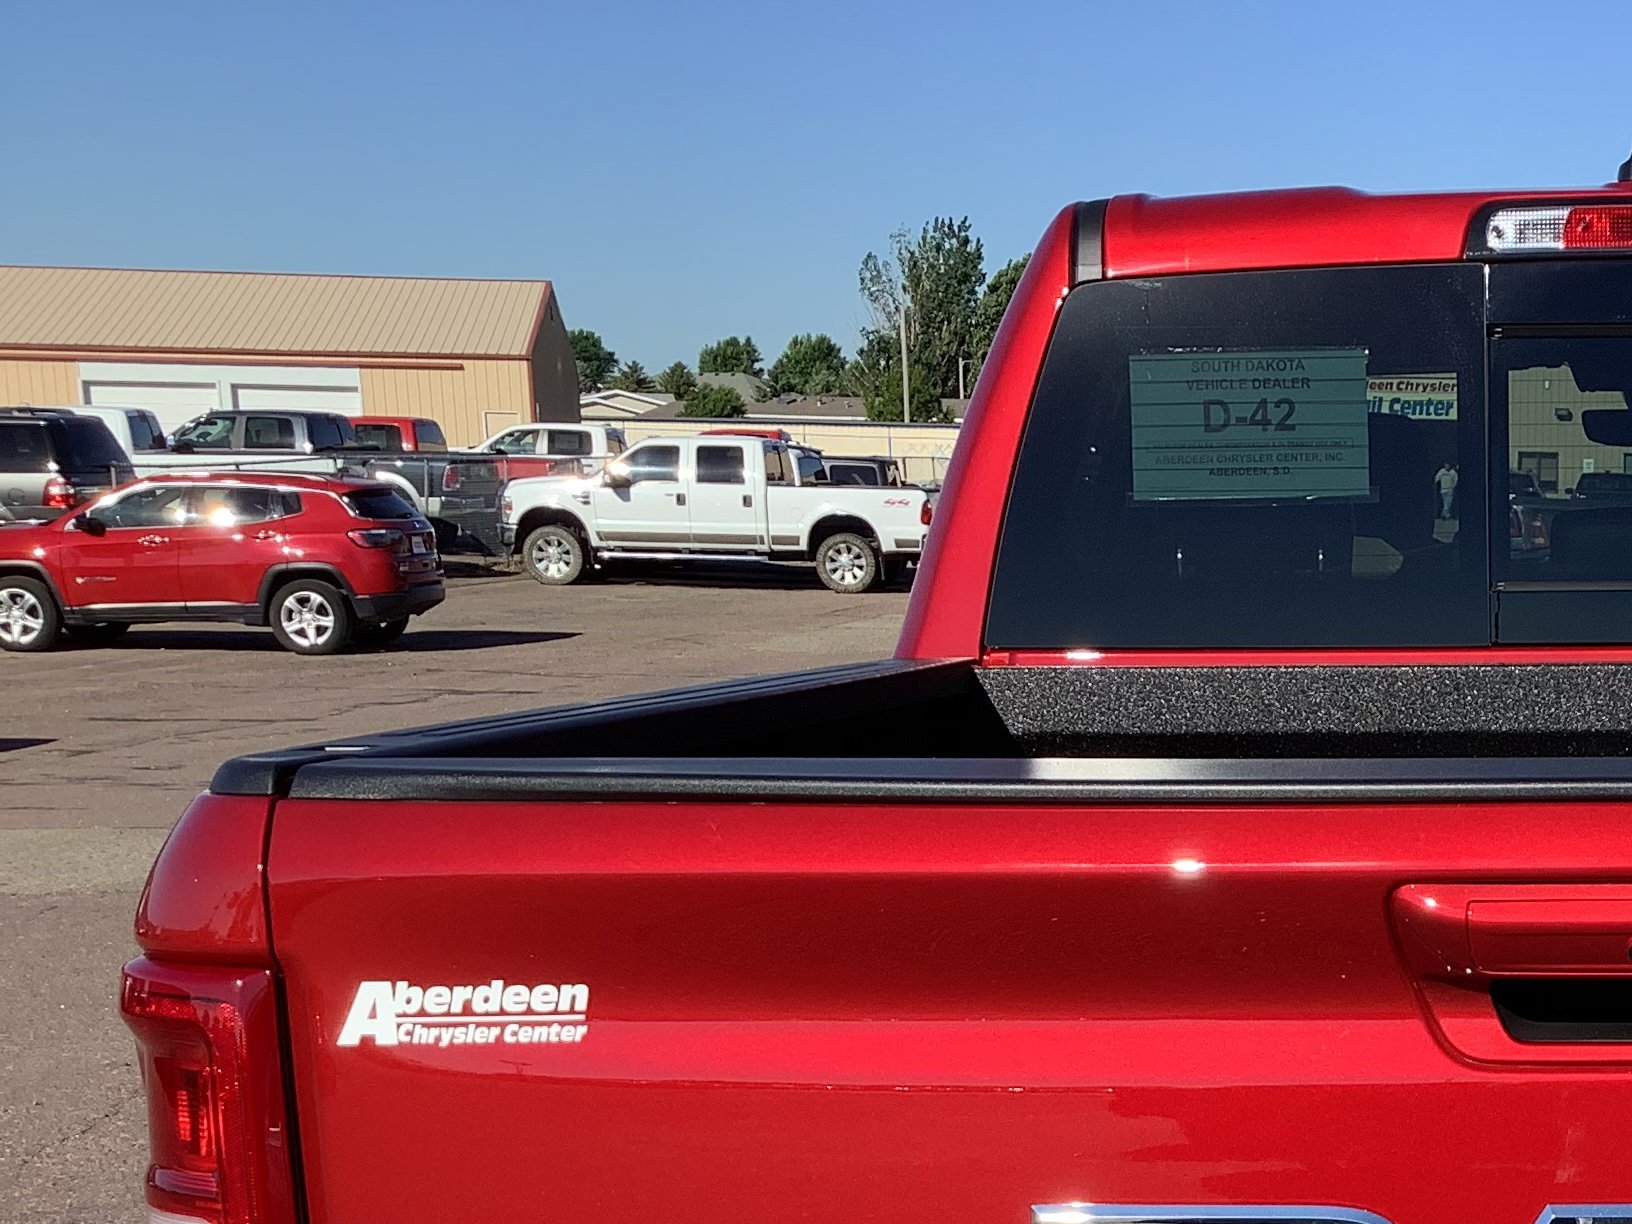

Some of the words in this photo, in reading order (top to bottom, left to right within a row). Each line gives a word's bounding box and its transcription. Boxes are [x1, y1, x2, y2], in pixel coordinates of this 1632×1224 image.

[1191, 360, 1242, 373] SOUTH
[1245, 358, 1306, 372] DAKOTA
[1186, 378, 1248, 391] VEHICLE
[1252, 376, 1311, 389] DEALER
[1396, 379, 1457, 393] Chrysler
[1203, 397, 1297, 433] D-42
[1389, 397, 1454, 416] Center
[1155, 452, 1214, 465] ABERDEEN
[1216, 451, 1273, 464] CHRYSLER
[336, 979, 589, 1047] Aberdeen
[397, 1023, 501, 1047] Chrysler
[503, 1022, 589, 1044] Center
